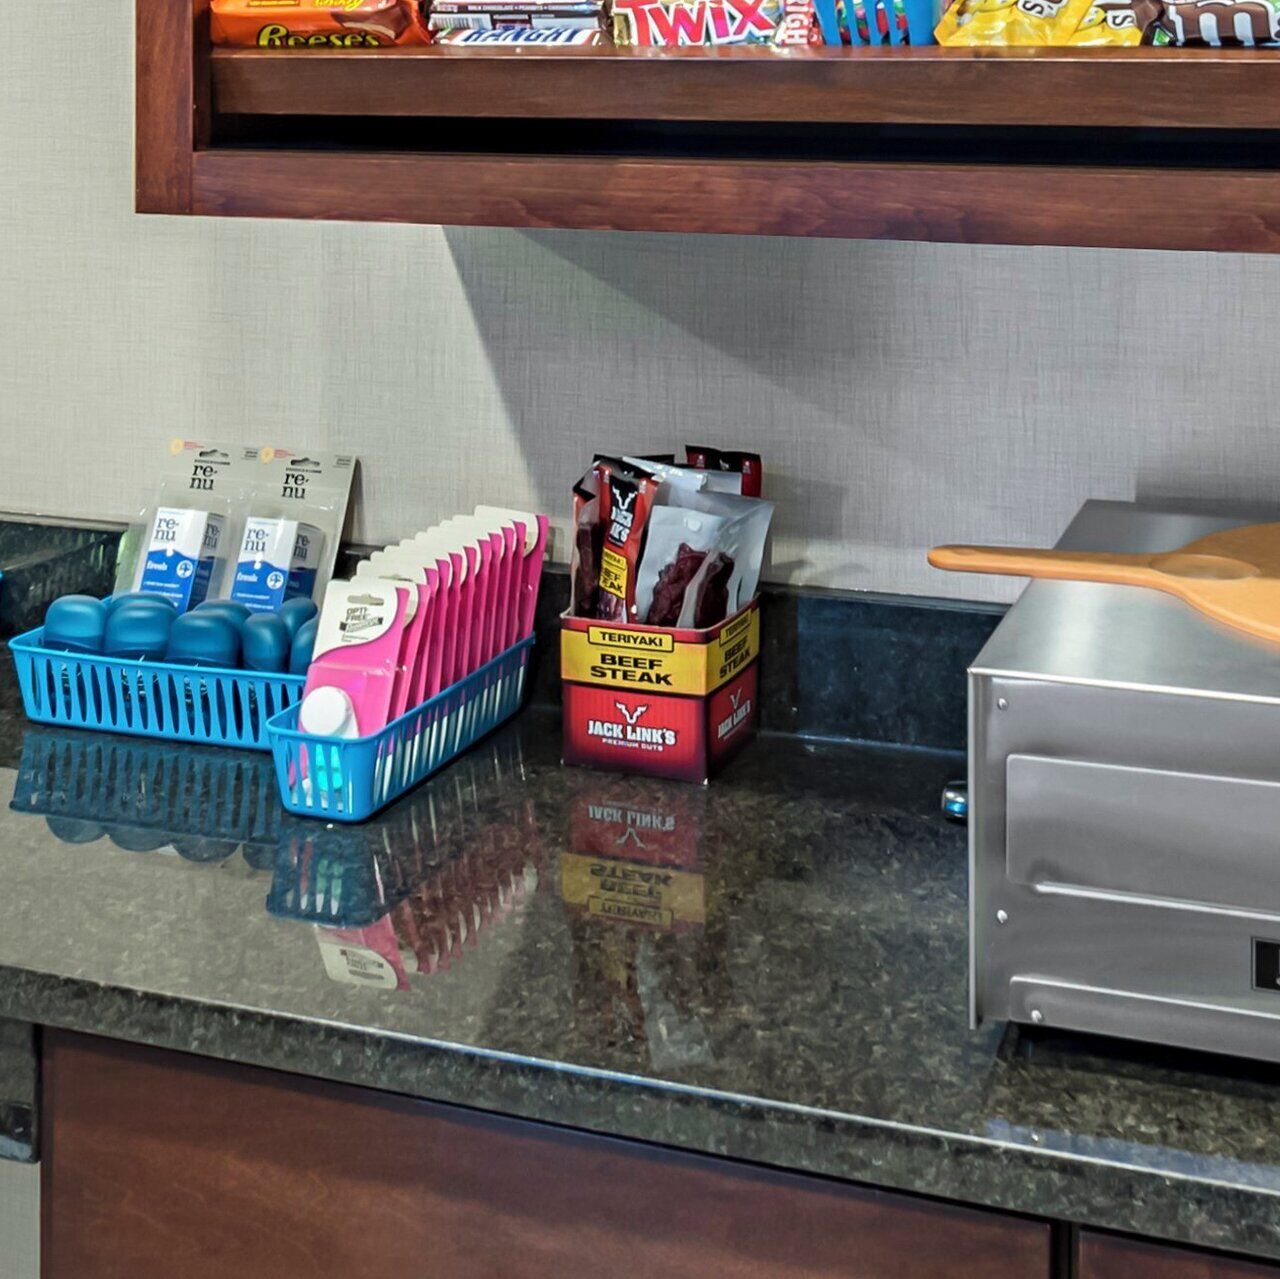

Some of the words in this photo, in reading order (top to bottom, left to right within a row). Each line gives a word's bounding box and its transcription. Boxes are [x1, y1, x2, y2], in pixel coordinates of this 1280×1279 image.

[260, 23, 381, 47] Reese's
[189, 477, 214, 490] nu
[281, 485, 306, 499] nu
[154, 530, 176, 541] nu
[244, 540, 266, 552] nu
[600, 631, 663, 647] TERIYAKI
[724, 636, 748, 662] BEEF
[600, 653, 663, 670] BEEF
[720, 648, 750, 677] STEAK
[590, 665, 673, 686] STEAK
[588, 720, 624, 738] JACK
[626, 725, 676, 746] LINK'S
[602, 738, 639, 748] PREMIUM
[641, 741, 664, 752] CUTS
